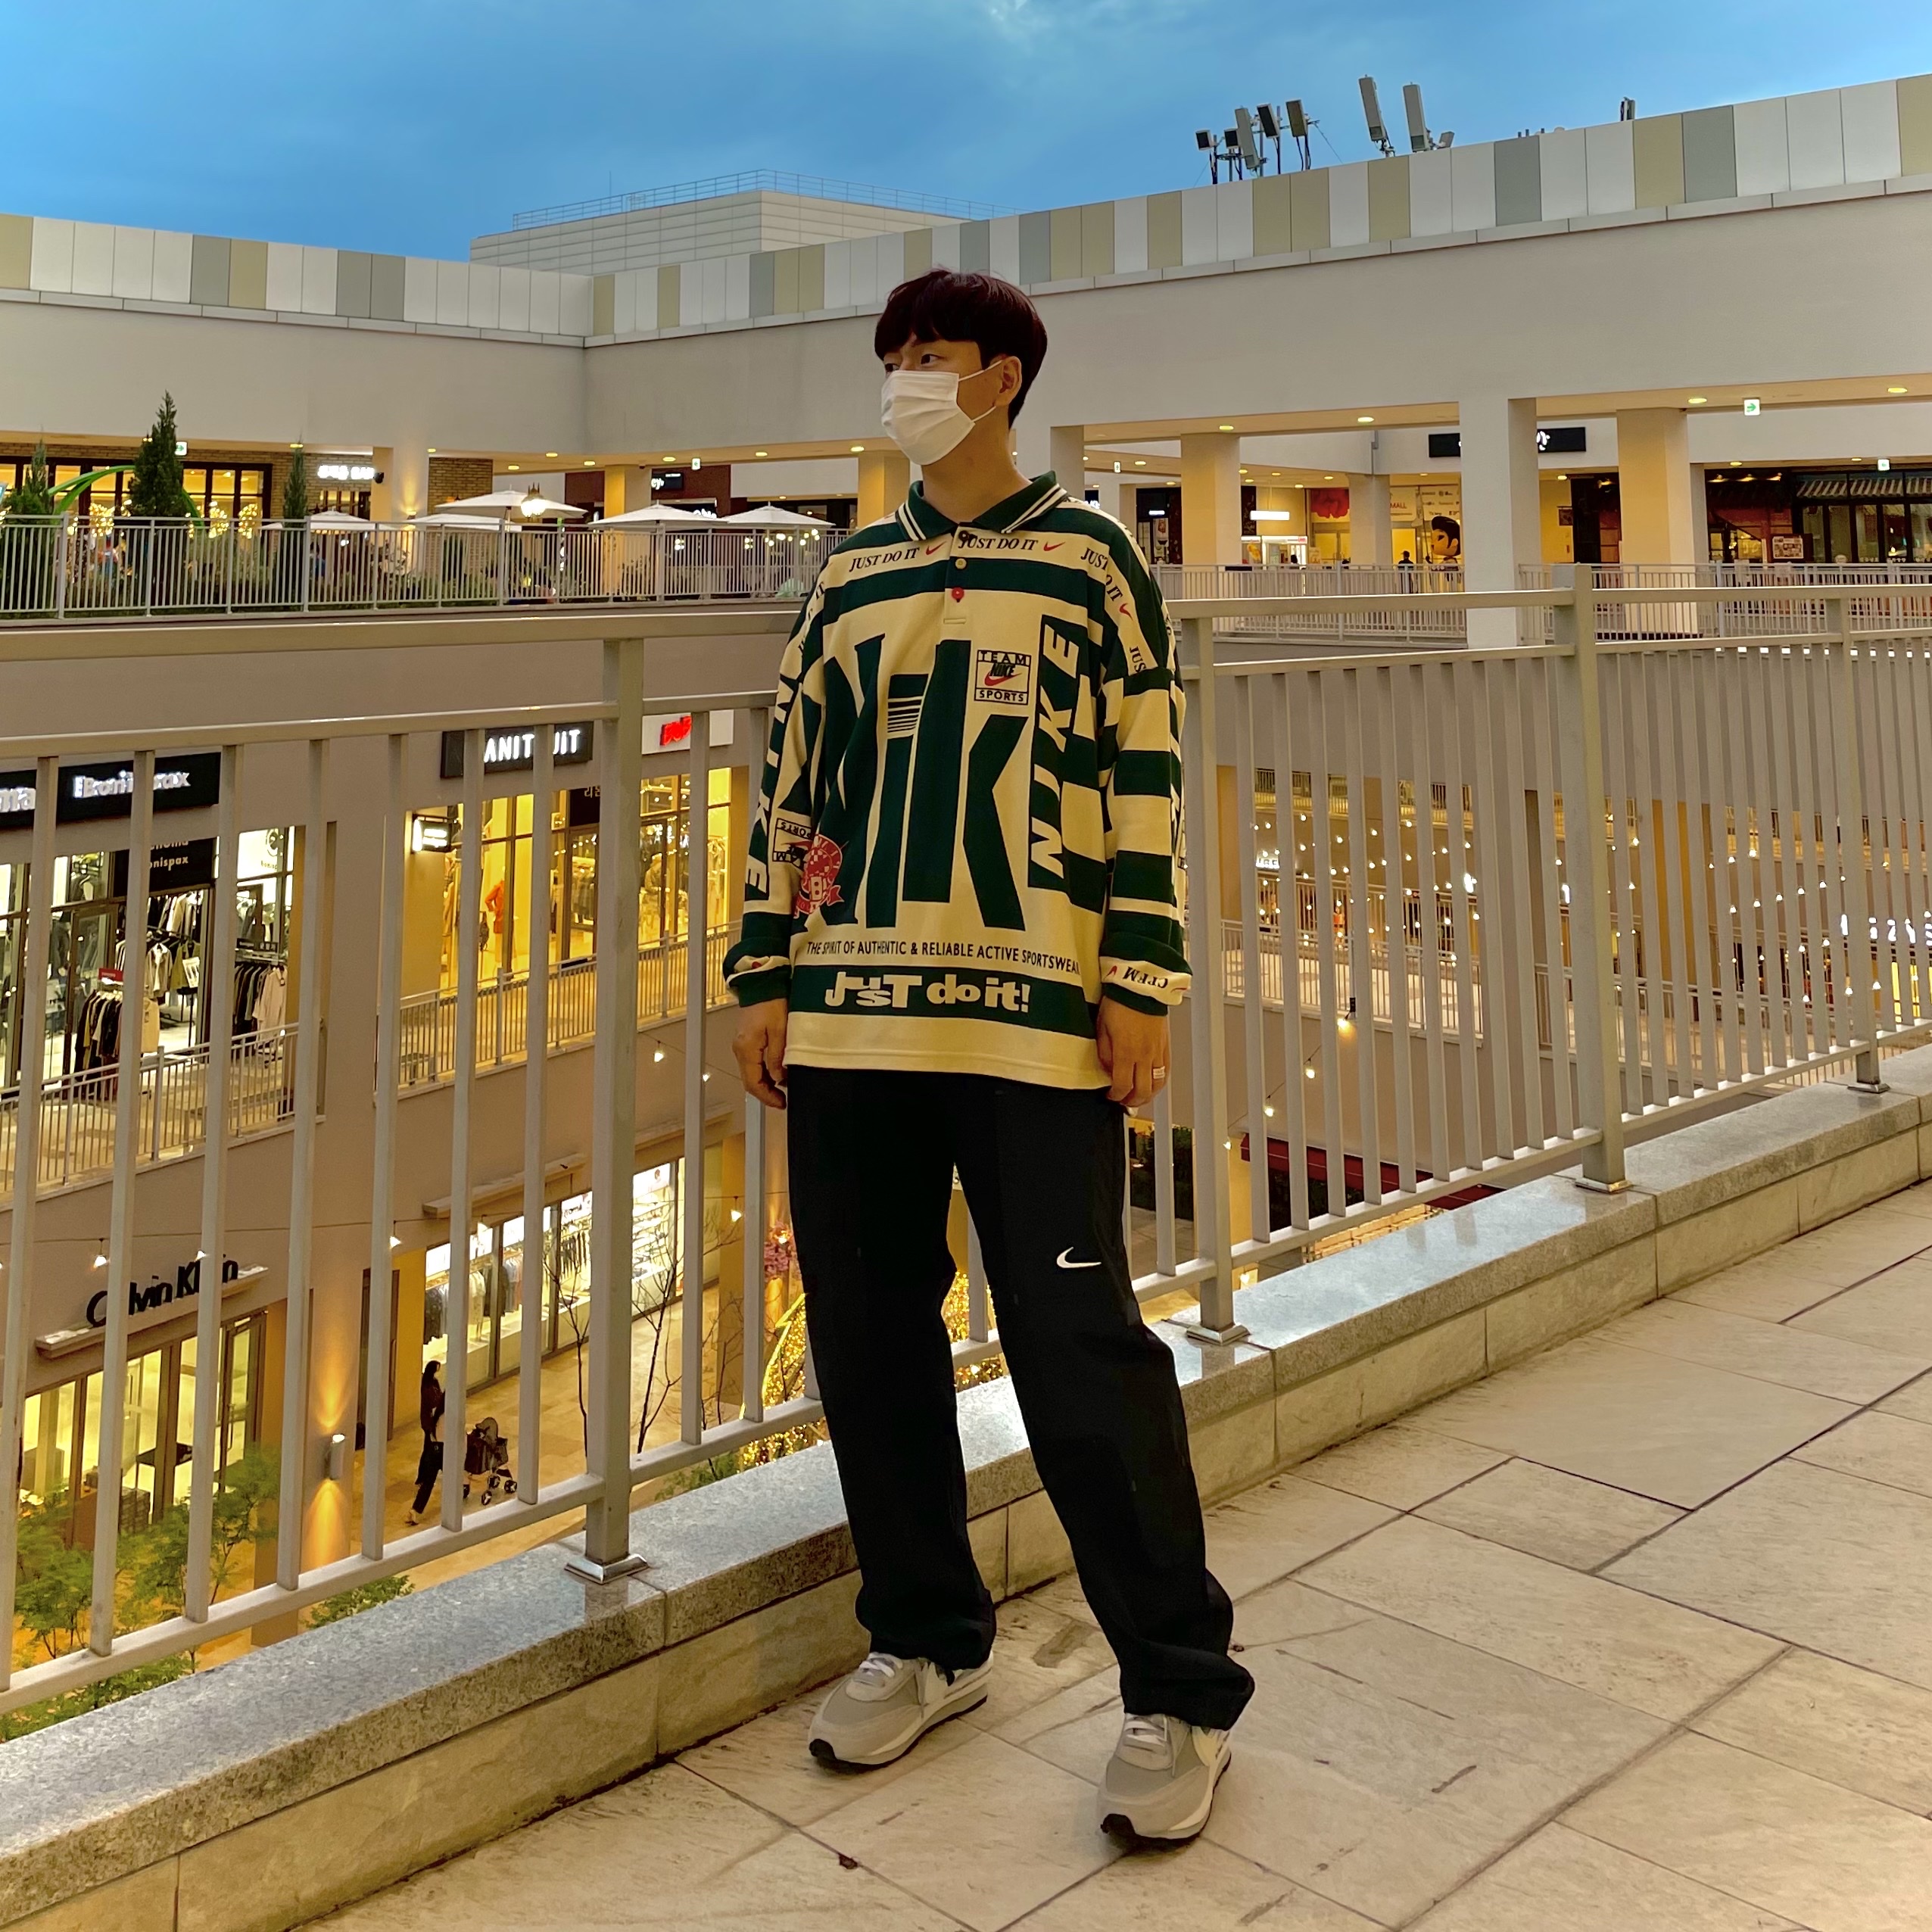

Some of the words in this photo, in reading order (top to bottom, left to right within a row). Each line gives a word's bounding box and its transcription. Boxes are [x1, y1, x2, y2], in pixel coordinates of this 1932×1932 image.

[958, 534, 996, 549] JUST
[996, 538, 1021, 550] DO
[1021, 538, 1039, 551] IT
[849, 553, 882, 572] JUST
[882, 551, 903, 564] DO
[904, 547, 921, 560] IT
[1107, 584, 1123, 602] IT
[980, 651, 1027, 666] TEAM
[1129, 646, 1147, 673] JUS
[979, 690, 1024, 702] SPORTS
[150, 856, 189, 871] nispax
[806, 941, 822, 955] THE
[843, 940, 855, 955] OF
[857, 940, 907, 955] AUTHENTIC
[911, 942, 918, 955] &
[921, 942, 974, 957] RELIABLE
[977, 945, 1019, 961] ACTIVE
[1122, 965, 1169, 989] CPFM
[926, 974, 981, 1005] do
[984, 977, 1031, 1013] it!
[86, 1275, 173, 1328] Clvin
[176, 1254, 238, 1298] Kln
